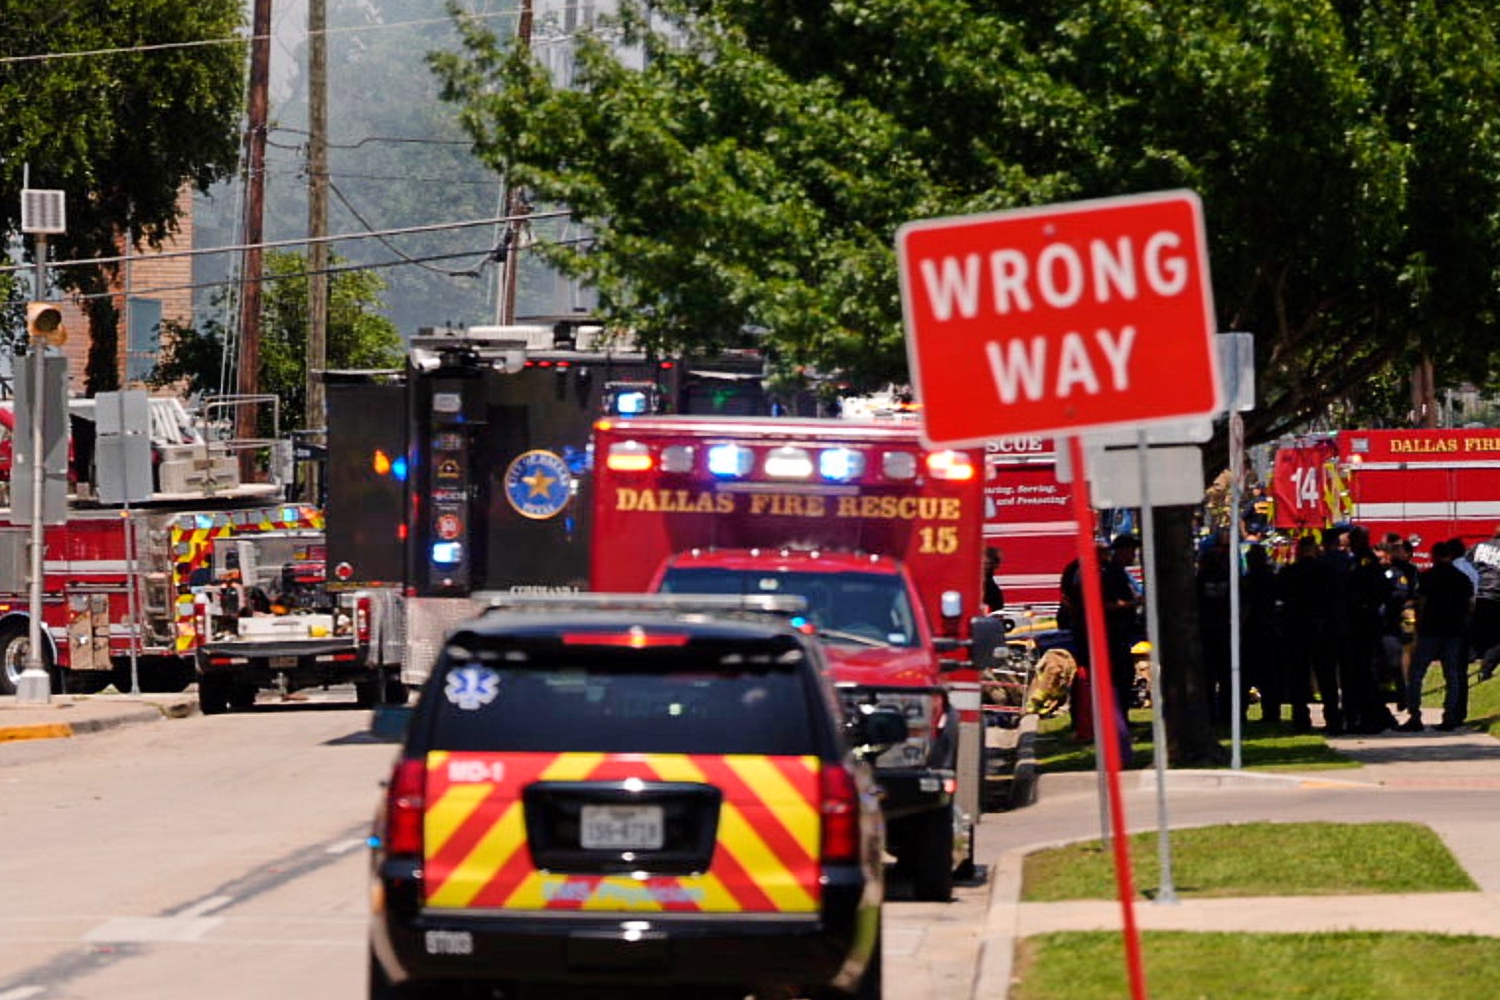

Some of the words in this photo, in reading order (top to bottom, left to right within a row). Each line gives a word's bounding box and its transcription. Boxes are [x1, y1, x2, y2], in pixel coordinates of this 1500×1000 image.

[920, 230, 1188, 321] WRONG
[986, 325, 1136, 404] WAY
[985, 437, 1043, 453] SCUE
[1390, 439, 1458, 453] DALLAS
[1291, 467, 1319, 508] 14
[616, 488, 735, 513] DALLAS
[749, 494, 825, 517] FIRE
[837, 495, 961, 520] RESCUE
[918, 528, 957, 553] 15
